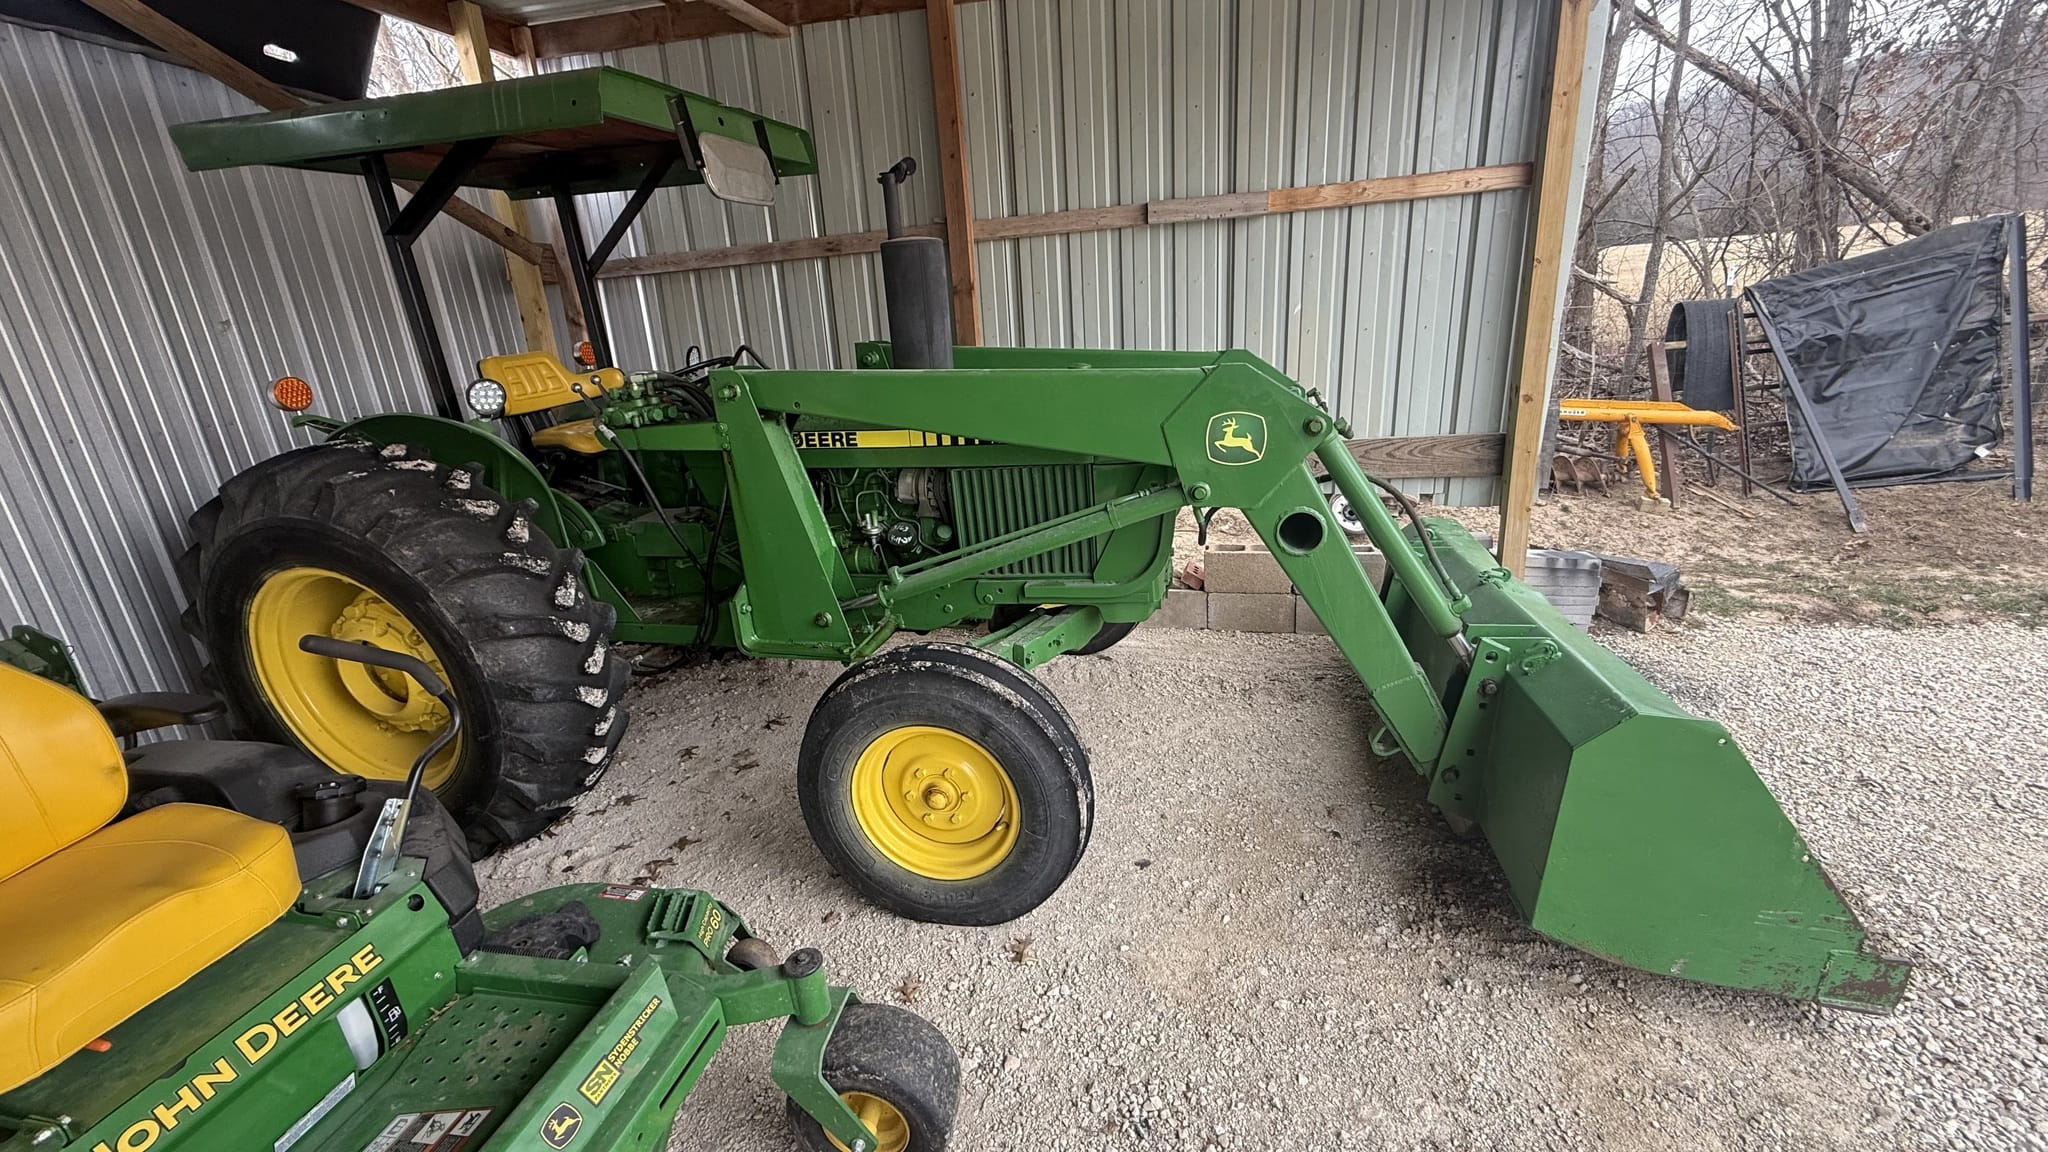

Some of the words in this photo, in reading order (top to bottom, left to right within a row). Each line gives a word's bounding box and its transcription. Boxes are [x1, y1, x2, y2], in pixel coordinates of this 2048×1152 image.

[793, 432, 858, 447] DEERE
[710, 908, 721, 930] 60
[607, 998, 661, 1062] SYDENSTRICKER
[90, 1056, 240, 1152] OHN
[234, 943, 384, 1065] DEERE
[614, 1038, 639, 1068] NOBBE
